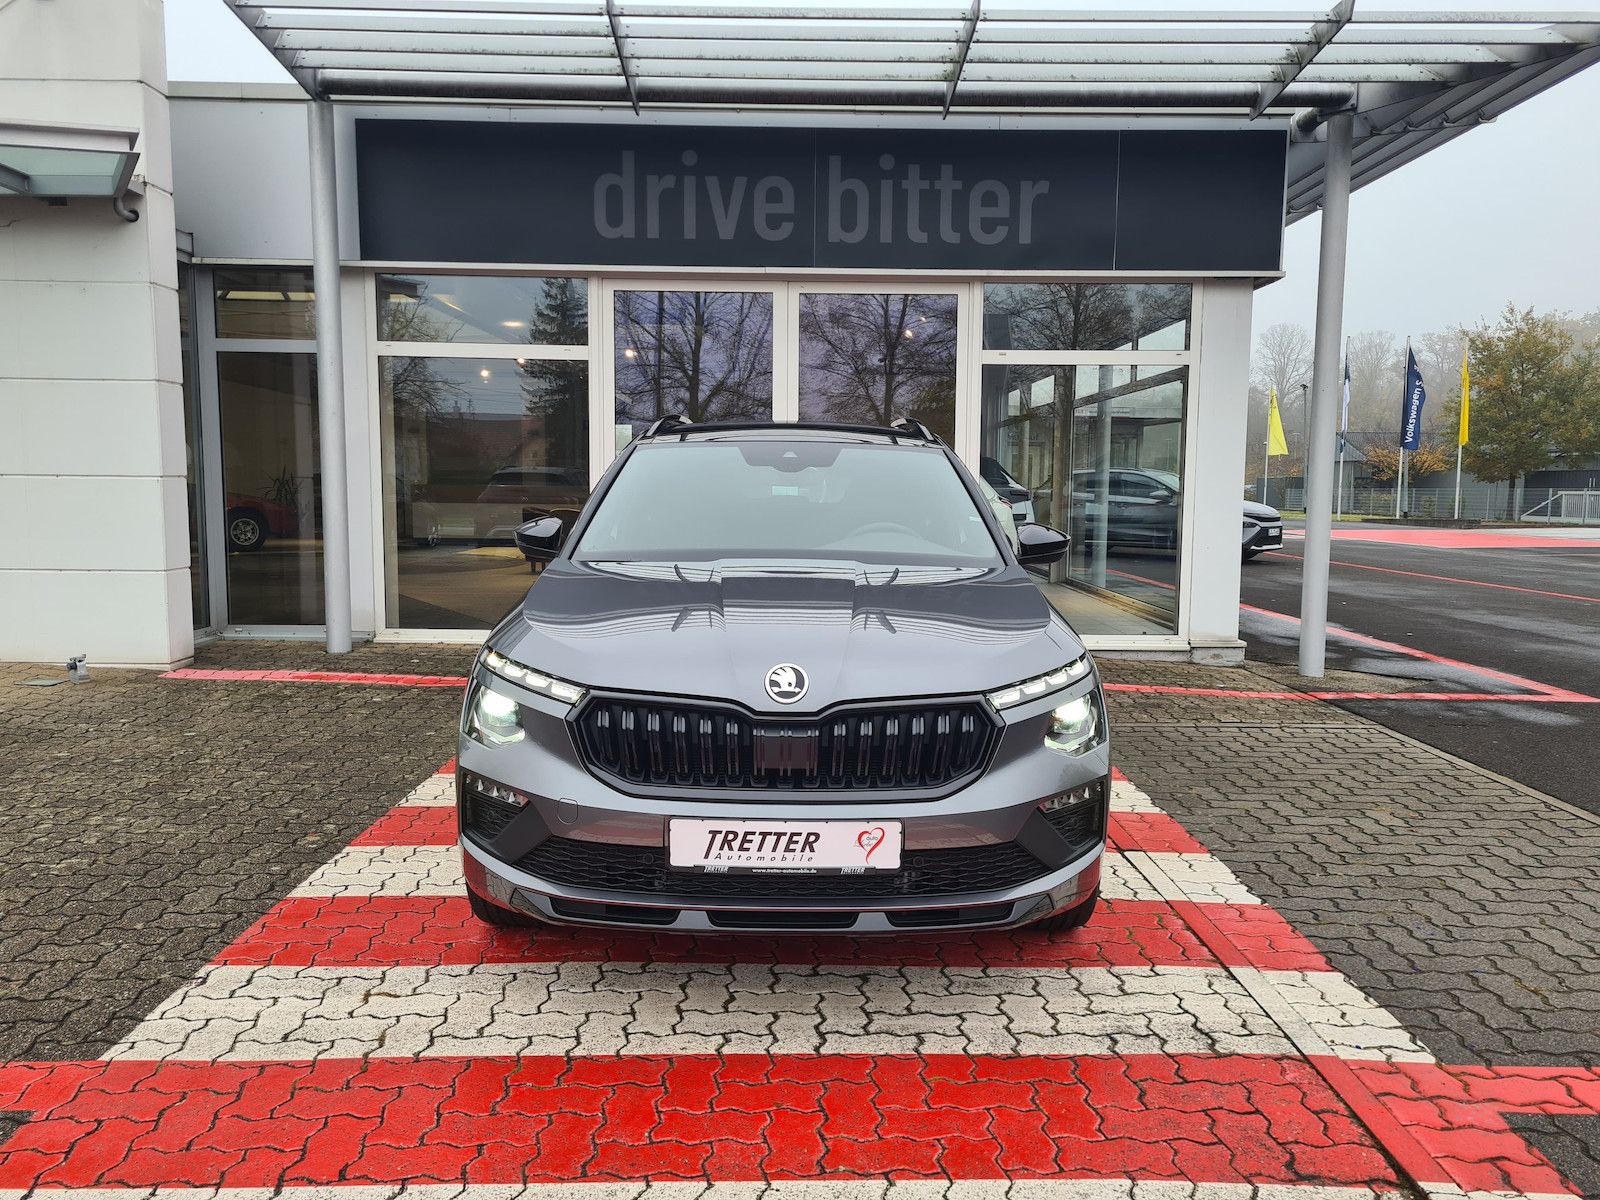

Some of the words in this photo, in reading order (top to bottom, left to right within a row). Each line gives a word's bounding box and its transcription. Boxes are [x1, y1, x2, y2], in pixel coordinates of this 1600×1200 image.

[593, 150, 795, 241] drive
[828, 153, 1050, 245] bitter
[1404, 387, 1422, 443] Volkswagen
[703, 829, 821, 860] TRETTER
[714, 852, 814, 862] Automobile
